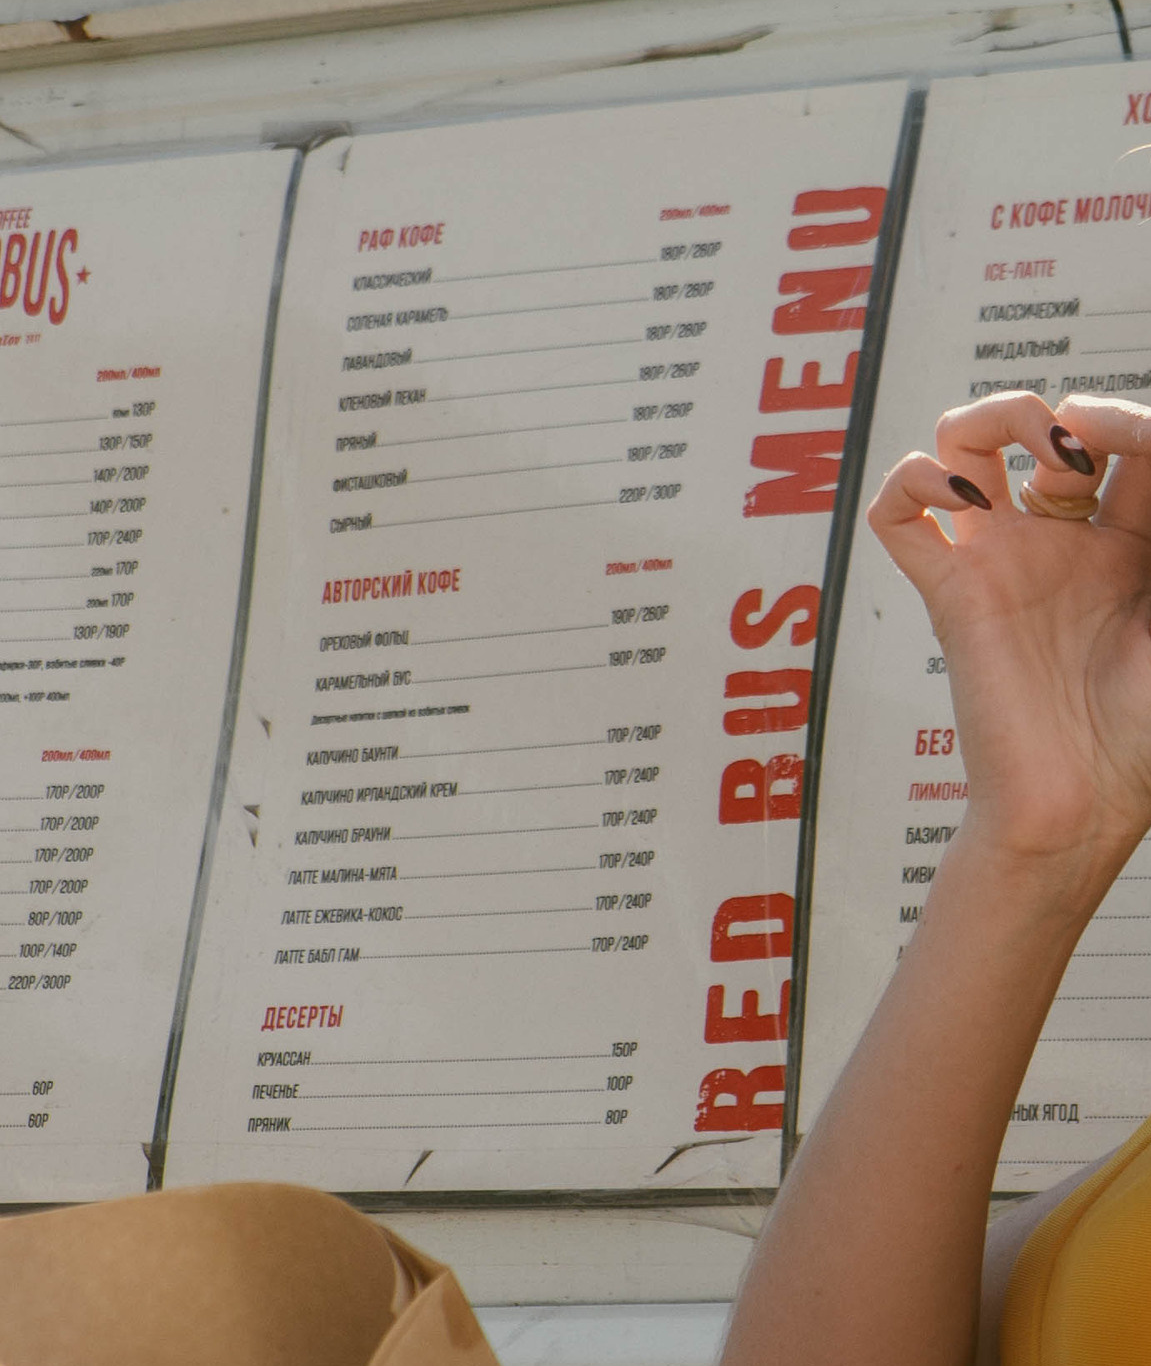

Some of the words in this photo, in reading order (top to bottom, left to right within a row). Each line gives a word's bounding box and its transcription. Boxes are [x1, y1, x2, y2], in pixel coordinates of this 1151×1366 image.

[991, 204, 1005, 230] С
[1010, 199, 1068, 229] КОФЕ
[358, 228, 394, 253] РАФ
[398, 223, 445, 247] КОФЕ
[0, 227, 78, 325] BUS
[353, 267, 432, 291] КЛАССИЧЕСКИЙ
[396, 307, 449, 326] КАРАМЕЛЬ
[979, 298, 1080, 323] КЛАССИЧЕСКИЙ
[342, 349, 412, 372] ЛАВАНДОВЫЙ
[743, 187, 889, 518] MENU
[975, 337, 1070, 361] МИНДАЛЬНЫЙ
[339, 390, 392, 412] КЛЕНОВЫЙ
[394, 389, 426, 406] ПЕКАН
[336, 432, 377, 452] ПРЯНЫЙ
[332, 469, 408, 492] ФИСТАШКОВЫЙ
[330, 513, 373, 534] СЫРНЫЙ
[321, 570, 412, 604] АВТОРСКИЙ
[417, 568, 461, 595] КОФЕ
[319, 631, 372, 652] ОРЕХОВЫЙ
[315, 670, 390, 692] КАРАМЕЛЬНЫЙ
[393, 670, 412, 685] БУС
[718, 584, 823, 825] BUS
[915, 729, 955, 756] БЕЗ
[306, 750, 358, 766] КАПУЧИНО
[361, 746, 399, 763] БАУНТИ
[46, 784, 105, 800] 170Р/200Р
[301, 788, 353, 805] КАПУЧИНО
[356, 782, 427, 803] ИРЛАНДСКИЙ
[429, 782, 458, 798] КРЕМ
[604, 766, 660, 785] 170Р/240Р
[40, 816, 99, 831] 170Р/200Р
[295, 828, 348, 845] КАПУЧИНО
[351, 827, 391, 843] БРАУНИ
[602, 808, 657, 827] 170Р/240Р
[34, 847, 94, 863] 170Р/200Р
[288, 869, 319, 885] ЛАТТЕ
[321, 866, 397, 884] МАЛИНА-МЯТА
[599, 850, 655, 869] 170Р/240Р
[29, 879, 88, 894] 170Р/200Р
[27, 911, 83, 926] 80Р/100Р
[281, 910, 312, 925] ЛАТТЕ
[314, 906, 404, 924] ЕЖЕВИКА-КОКОС
[595, 893, 652, 911] 170Р/240Р
[20, 943, 78, 958] 100Р/140Р
[274, 950, 305, 965] ЛАТТЕ
[307, 949, 335, 964] БАБЛ
[338, 948, 360, 963] ГАМ
[591, 934, 649, 952] 170Р/240Р
[8, 975, 71, 990] 220Р/300Р
[261, 1005, 344, 1032] ДЕСЕРТЫ
[694, 892, 796, 1133] RED
[257, 1051, 311, 1067] КРУАССАН
[612, 1042, 638, 1057] 150Р
[32, 1081, 54, 1095] 60Р
[252, 1084, 299, 1099] ПЕЧЕНЬЕ
[606, 1075, 633, 1091] 100Р
[28, 1113, 49, 1128] 60Р
[247, 1117, 291, 1132] ПРЯНИК
[605, 1109, 628, 1124] 80Р
[1042, 1103, 1079, 1124] ЯГОД
